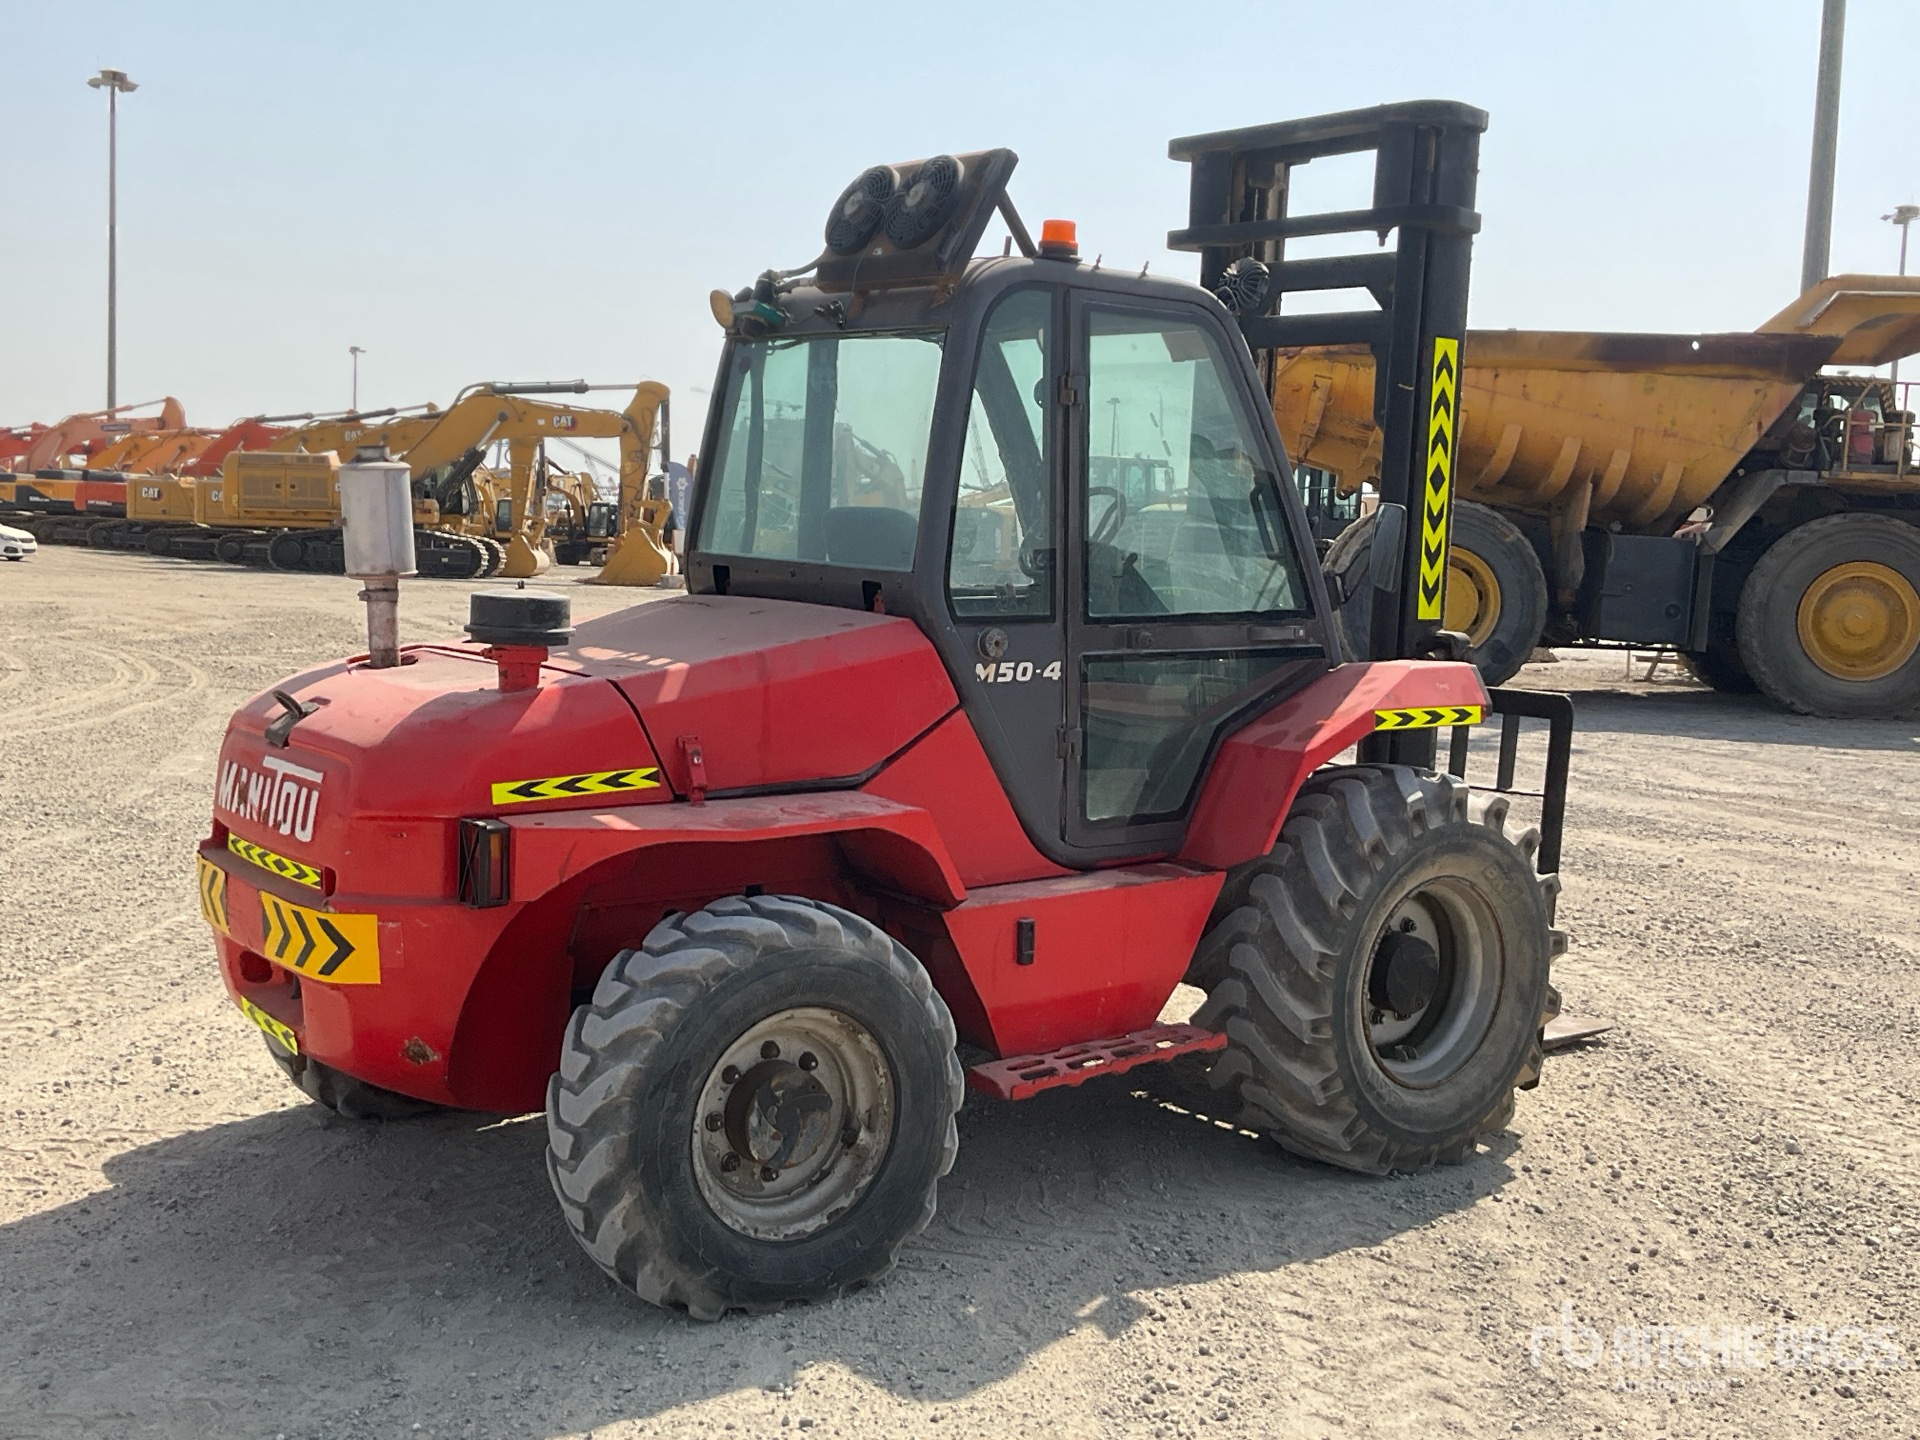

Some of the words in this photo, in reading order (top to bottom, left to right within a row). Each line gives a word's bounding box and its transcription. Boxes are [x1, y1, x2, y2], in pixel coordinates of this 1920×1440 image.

[553, 415, 573, 428] CAT
[142, 487, 160, 499] CAT
[212, 489, 224, 501] CA
[975, 661, 1062, 683] M50-4
[218, 755, 324, 843] MANITOU
